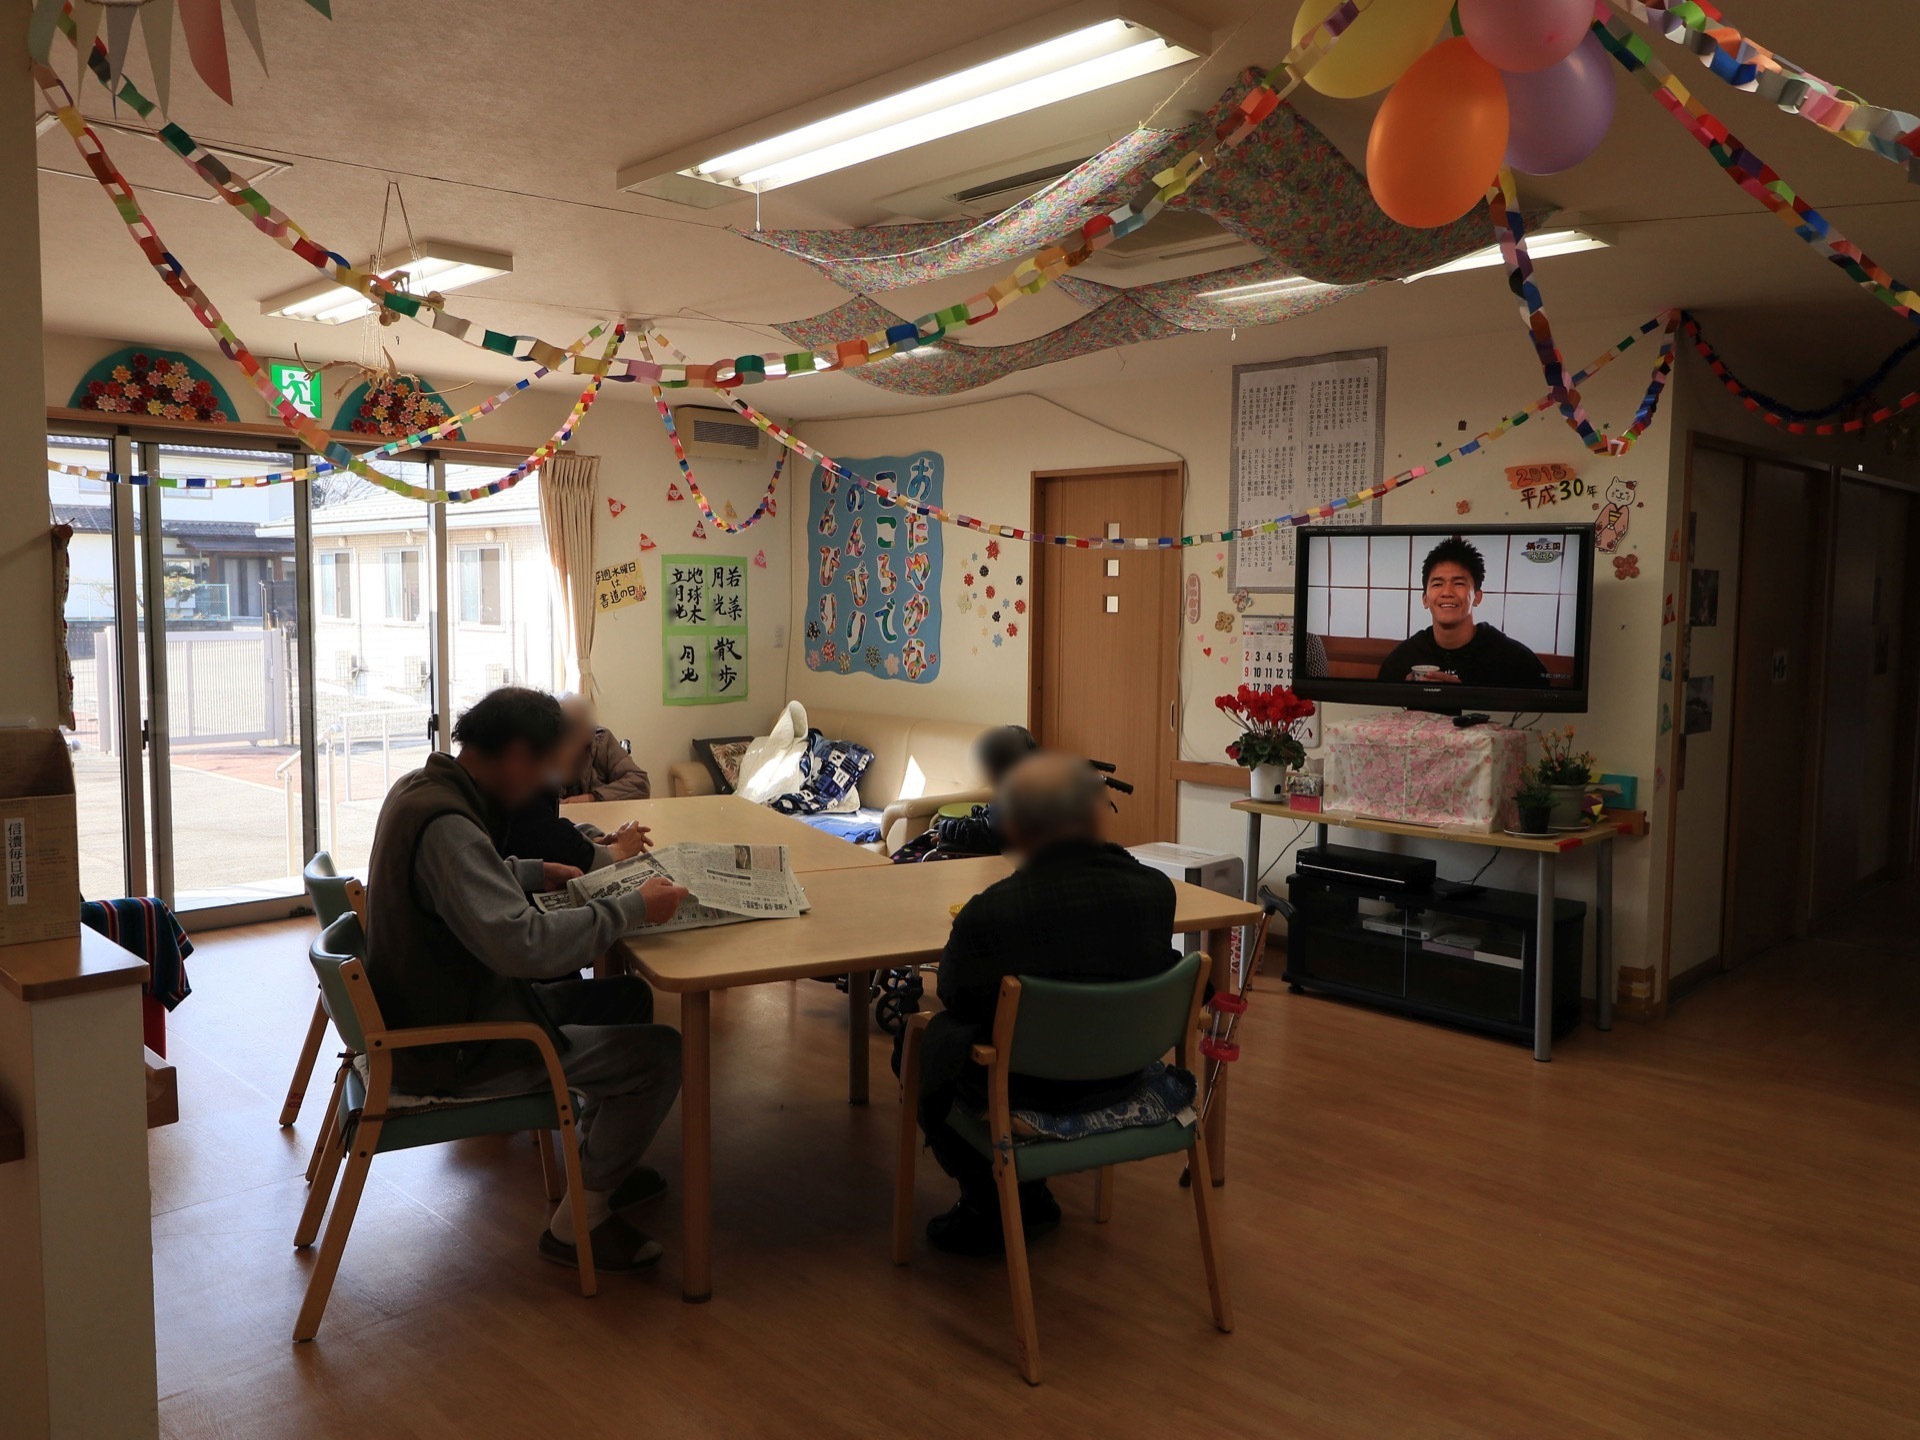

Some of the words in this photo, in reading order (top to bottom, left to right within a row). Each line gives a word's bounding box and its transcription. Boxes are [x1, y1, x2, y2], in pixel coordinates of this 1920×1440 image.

[1516, 464, 1567, 487] 2018
[1520, 478, 1598, 509] 平成30年
[846, 483, 869, 654] のんびり
[611, 578, 621, 588] は
[726, 566, 742, 621] 若菜
[600, 586, 636, 609] 書道の日
[1276, 622, 1287, 631] 12
[714, 636, 742, 692] 散歩
[1254, 667, 1261, 677] 10
[1265, 668, 1272, 678] 11
[1276, 668, 1284, 678] 12
[8, 822, 24, 898] 信濃毎日新聞
